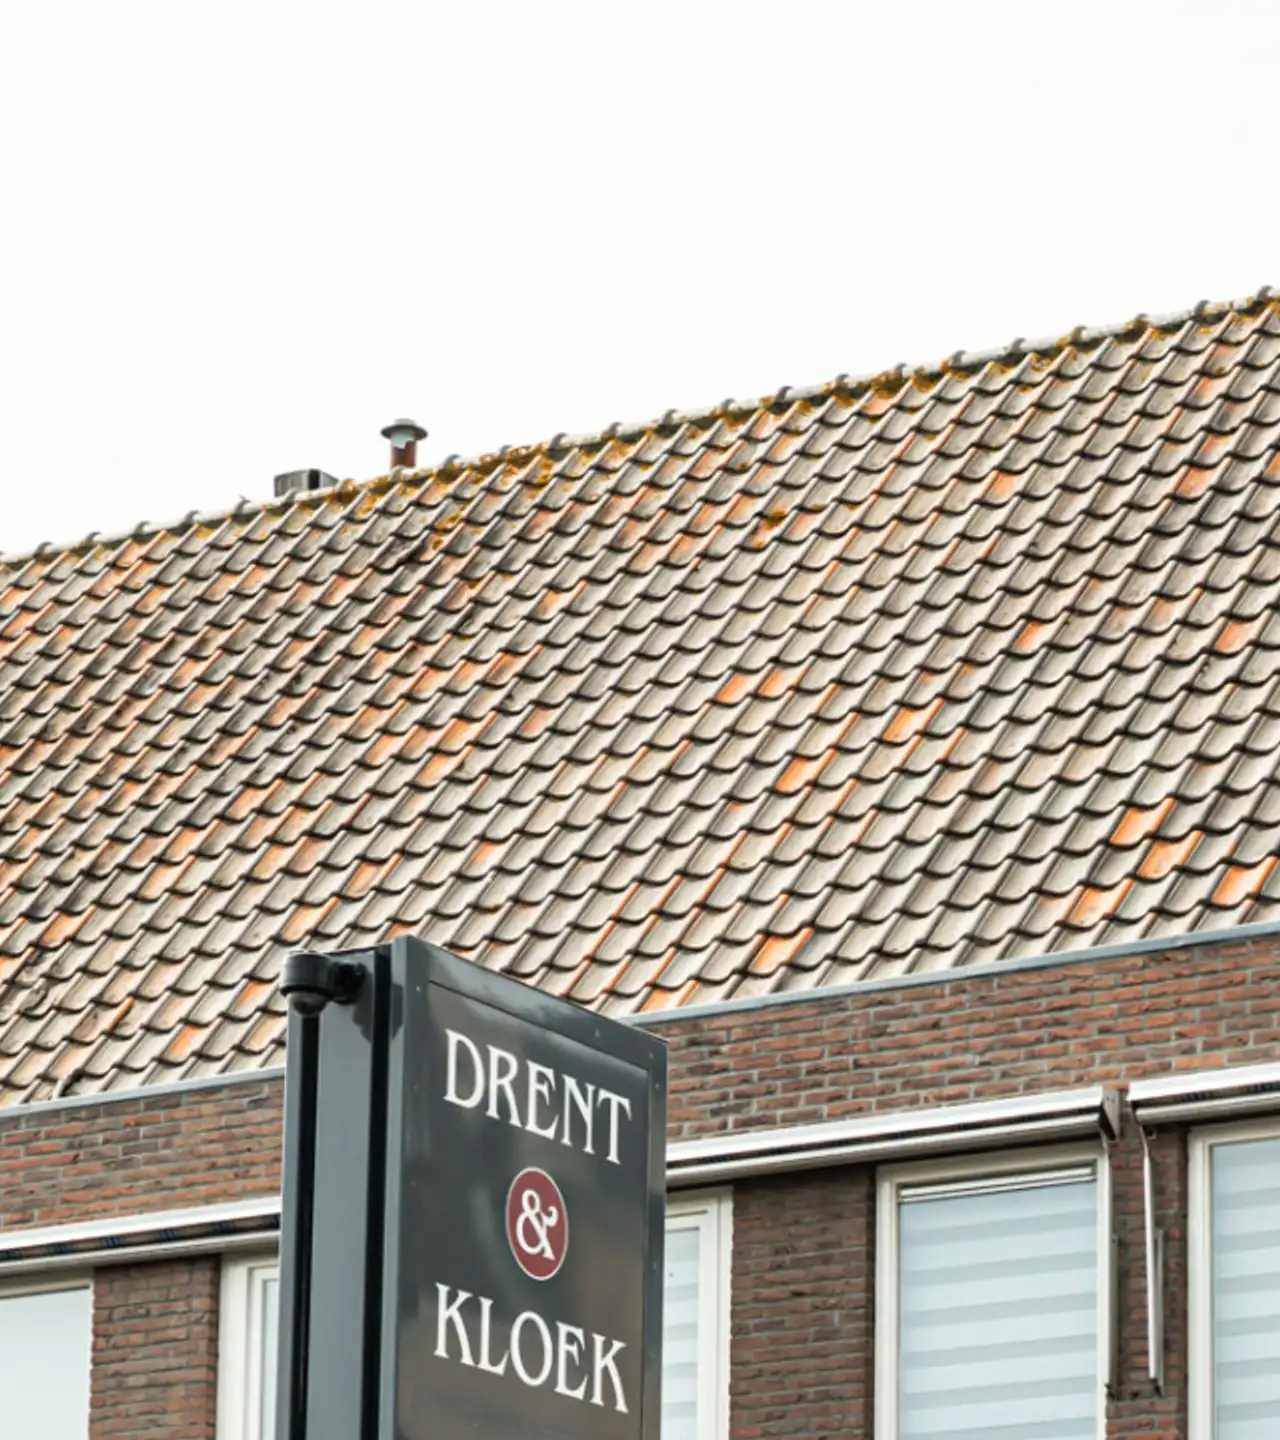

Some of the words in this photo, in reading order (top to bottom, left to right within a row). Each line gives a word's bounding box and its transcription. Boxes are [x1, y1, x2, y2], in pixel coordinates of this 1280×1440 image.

[444, 1028, 632, 1164] DRENT
[516, 1189, 559, 1260] &
[434, 1282, 629, 1414] KLOEK
